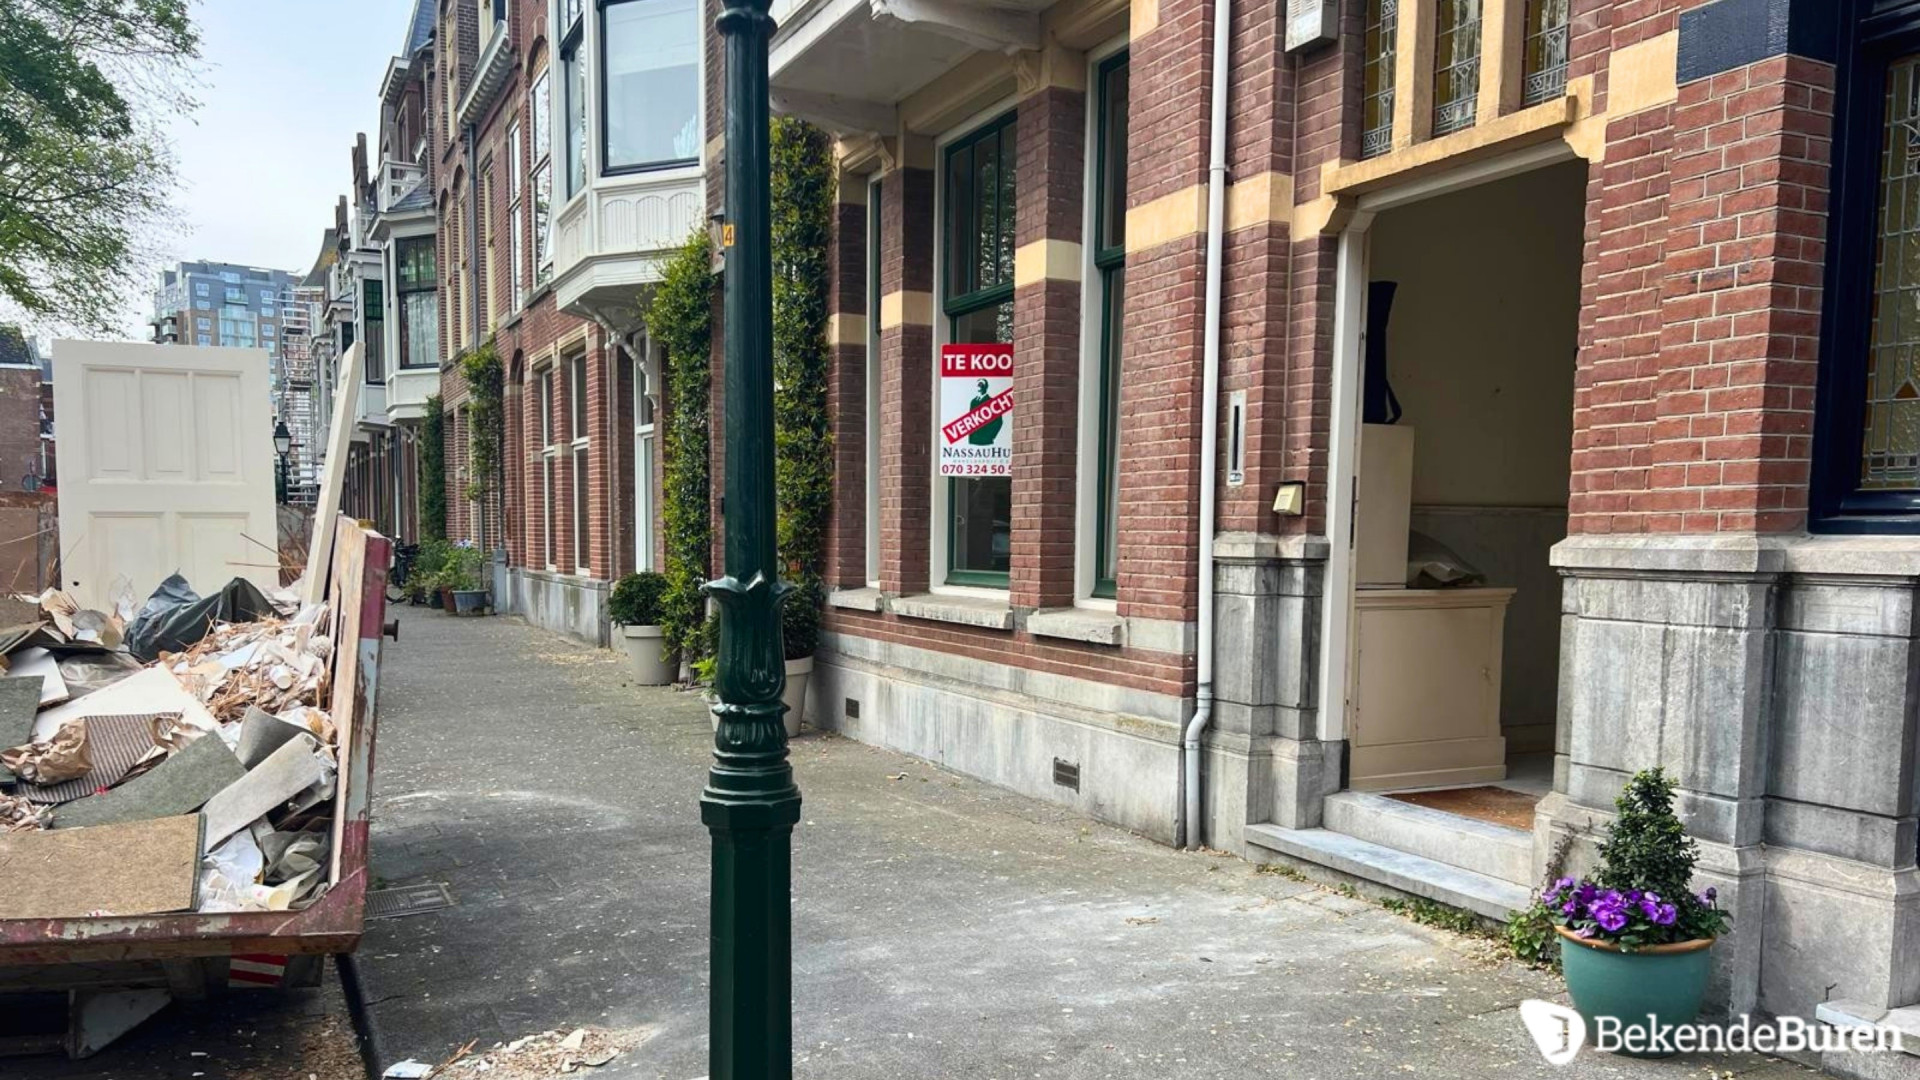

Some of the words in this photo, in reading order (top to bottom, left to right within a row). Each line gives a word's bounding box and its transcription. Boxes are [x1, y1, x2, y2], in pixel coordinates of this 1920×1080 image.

[943, 353, 966, 370] TE
[942, 465, 963, 474] 070
[967, 465, 988, 474] 324
[991, 465, 1005, 474] 50
